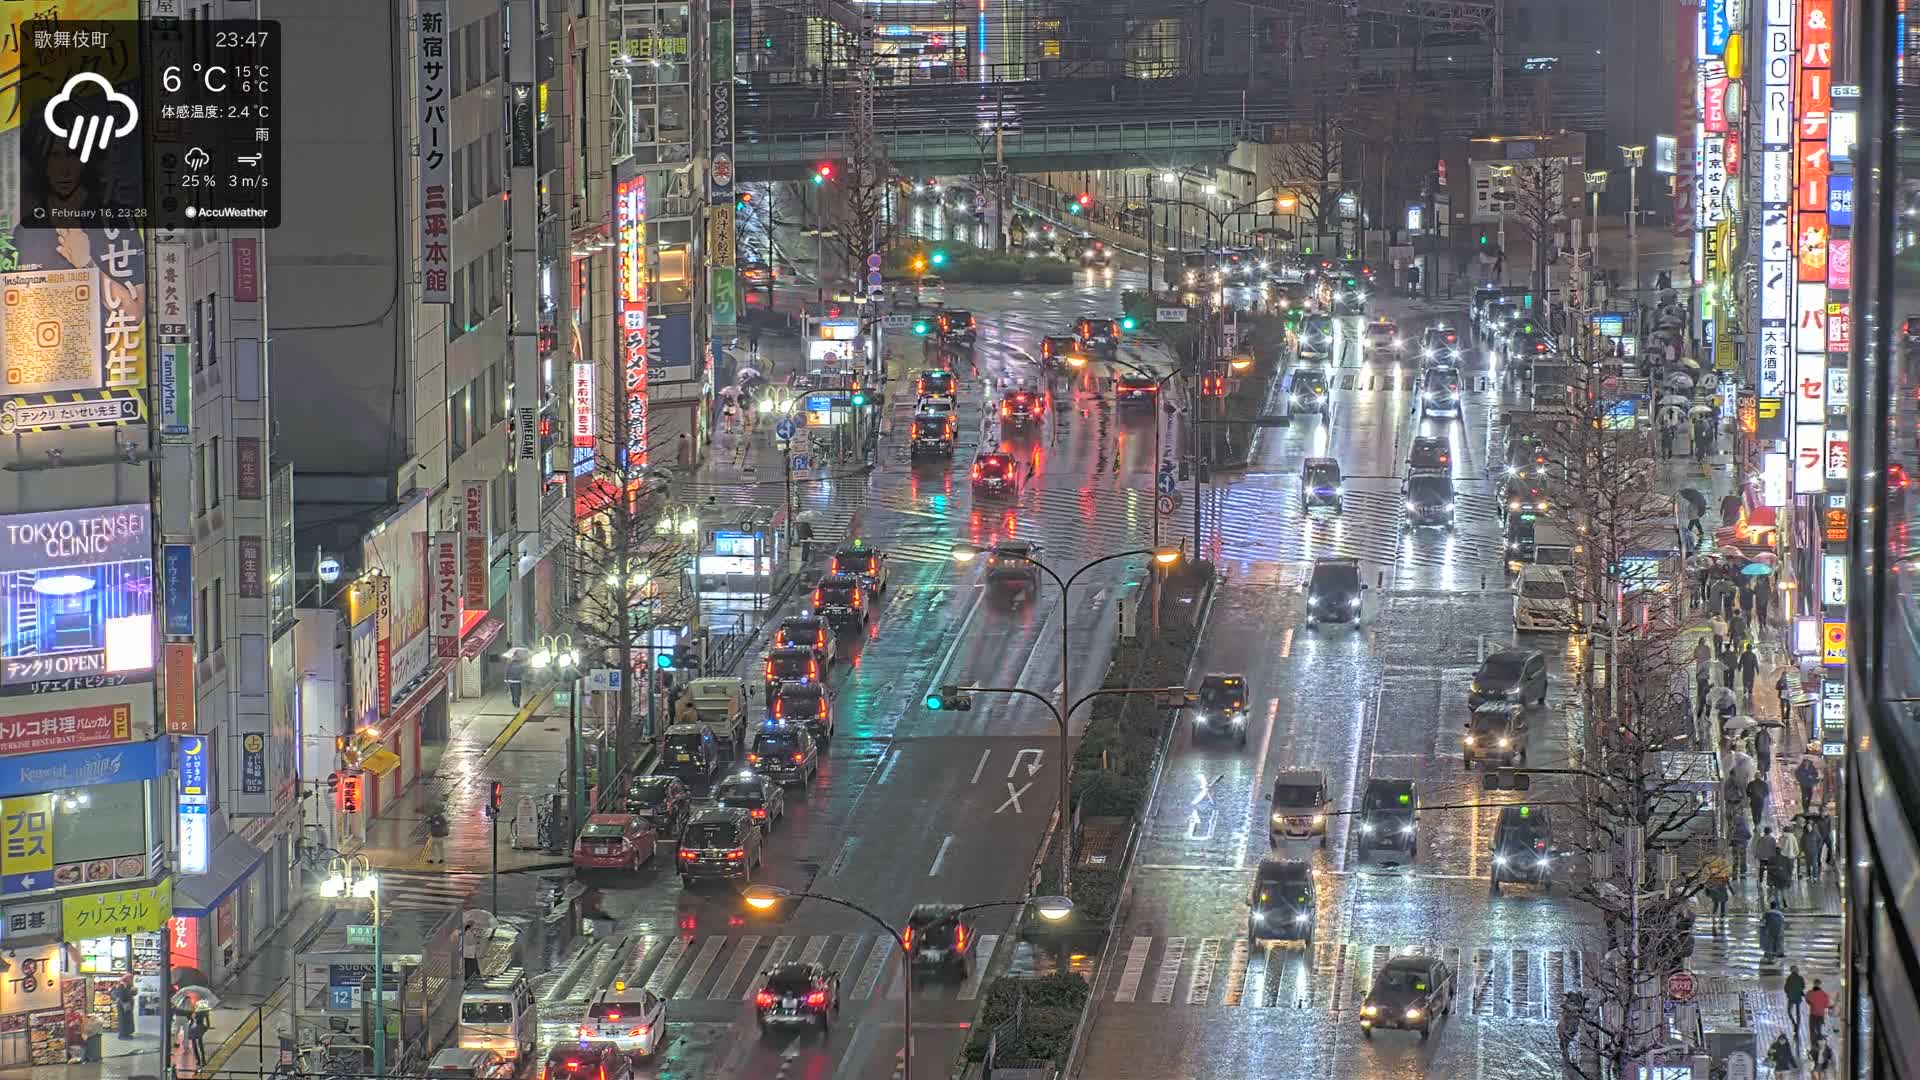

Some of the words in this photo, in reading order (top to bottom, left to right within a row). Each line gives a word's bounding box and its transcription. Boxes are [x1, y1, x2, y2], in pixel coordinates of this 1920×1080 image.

[422, 12, 446, 170] 新宿サンパーク
[1711, 87, 1722, 121] アコム
[714, 161, 731, 177] 薬
[425, 185, 449, 293] 三平本館
[716, 207, 730, 264] 肉汁水餃子
[3, 273, 48, 288] Instagram
[715, 277, 731, 314] レイク
[165, 325, 182, 334] 3F
[626, 331, 644, 388] ラーメン
[1764, 331, 1777, 382] 大衆酒場
[163, 354, 175, 416] FamilyMart
[1800, 309, 1824, 469] パセラ
[20, 408, 56, 421] テンクリ
[61, 405, 118, 421] たいせい先生
[519, 407, 534, 460] HOMEGAME
[467, 487, 478, 532] GAME
[7, 520, 75, 545] TOKYO
[79, 513, 144, 538] TENSEI
[46, 533, 109, 557] CLINIC
[439, 542, 456, 629] 三平ストア
[8, 659, 53, 678] テンクリ
[56, 653, 105, 673] OPEN!
[32, 675, 126, 693] リアエイドビジョン
[0, 716, 76, 739] トルコ料理
[77, 716, 112, 730] パムッカレ
[116, 711, 127, 737] 5F
[32, 736, 75, 749] RESTAURANT
[186, 805, 200, 814] 2F
[11, 911, 46, 931] 囲碁
[76, 903, 149, 928] クリスタル
[333, 991, 349, 1004] 12
